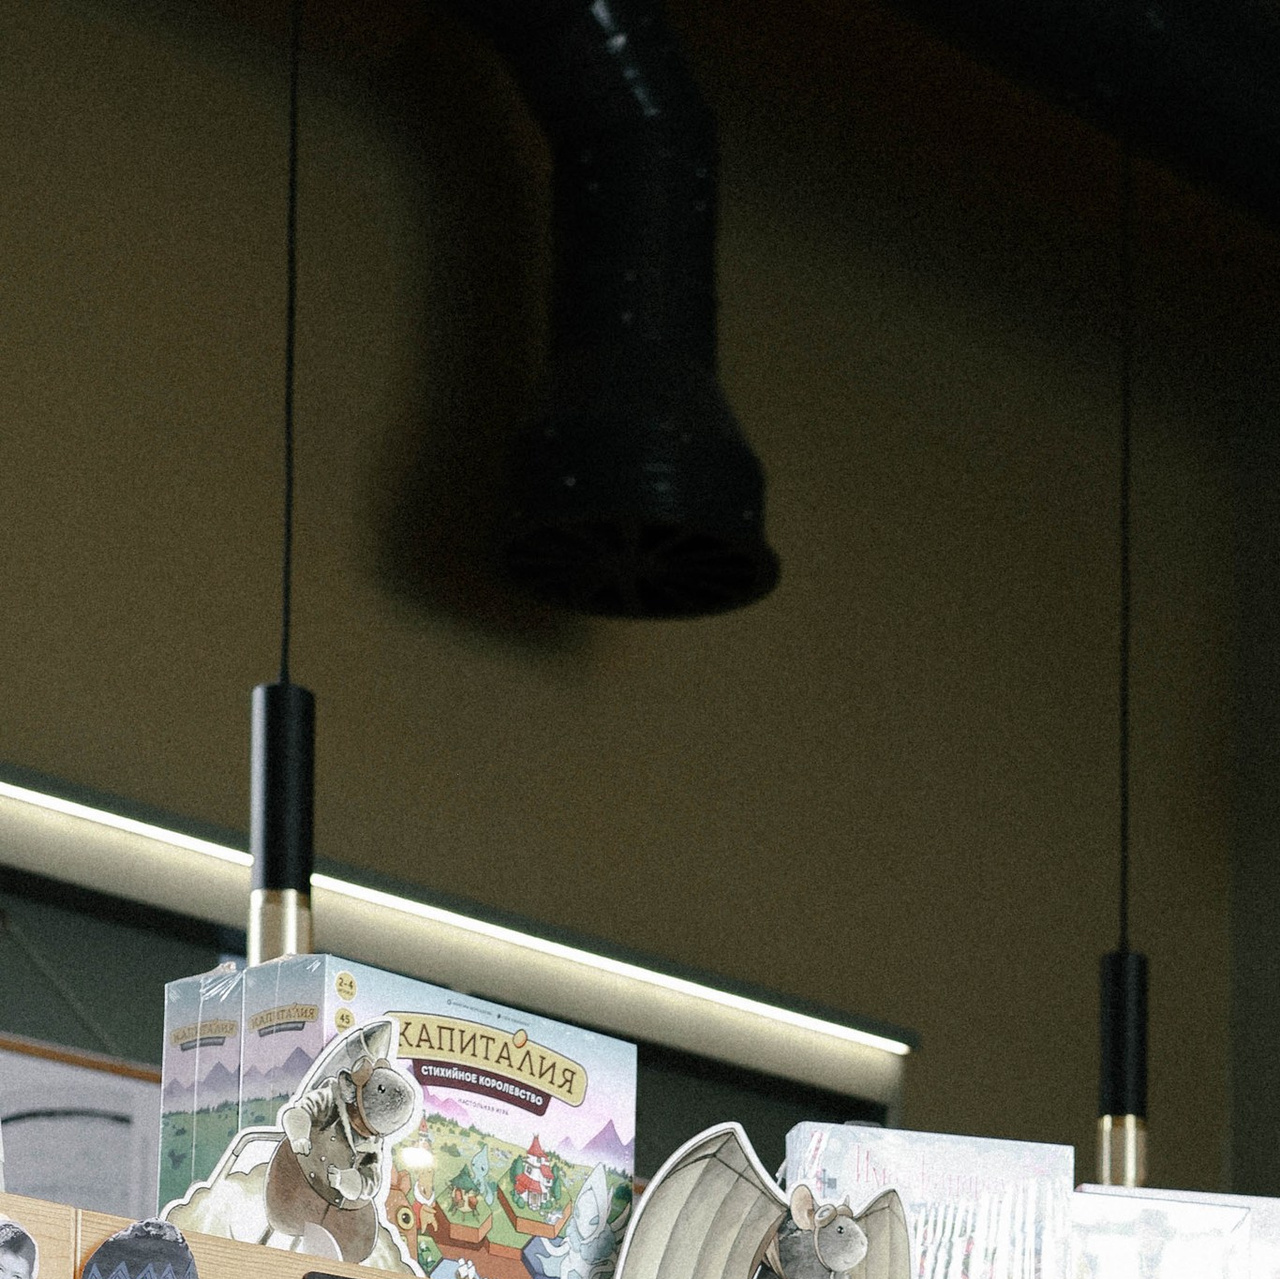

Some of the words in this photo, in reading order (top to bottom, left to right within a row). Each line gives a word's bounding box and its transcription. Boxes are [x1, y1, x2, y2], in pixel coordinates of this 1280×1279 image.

[340, 1014, 350, 1024] 45
[399, 1021, 577, 1094] КАПИТАЛИЯ
[421, 1065, 477, 1084] СТИХИЙНОЕ
[478, 1075, 543, 1106] КОРОЛЕВСТВО
